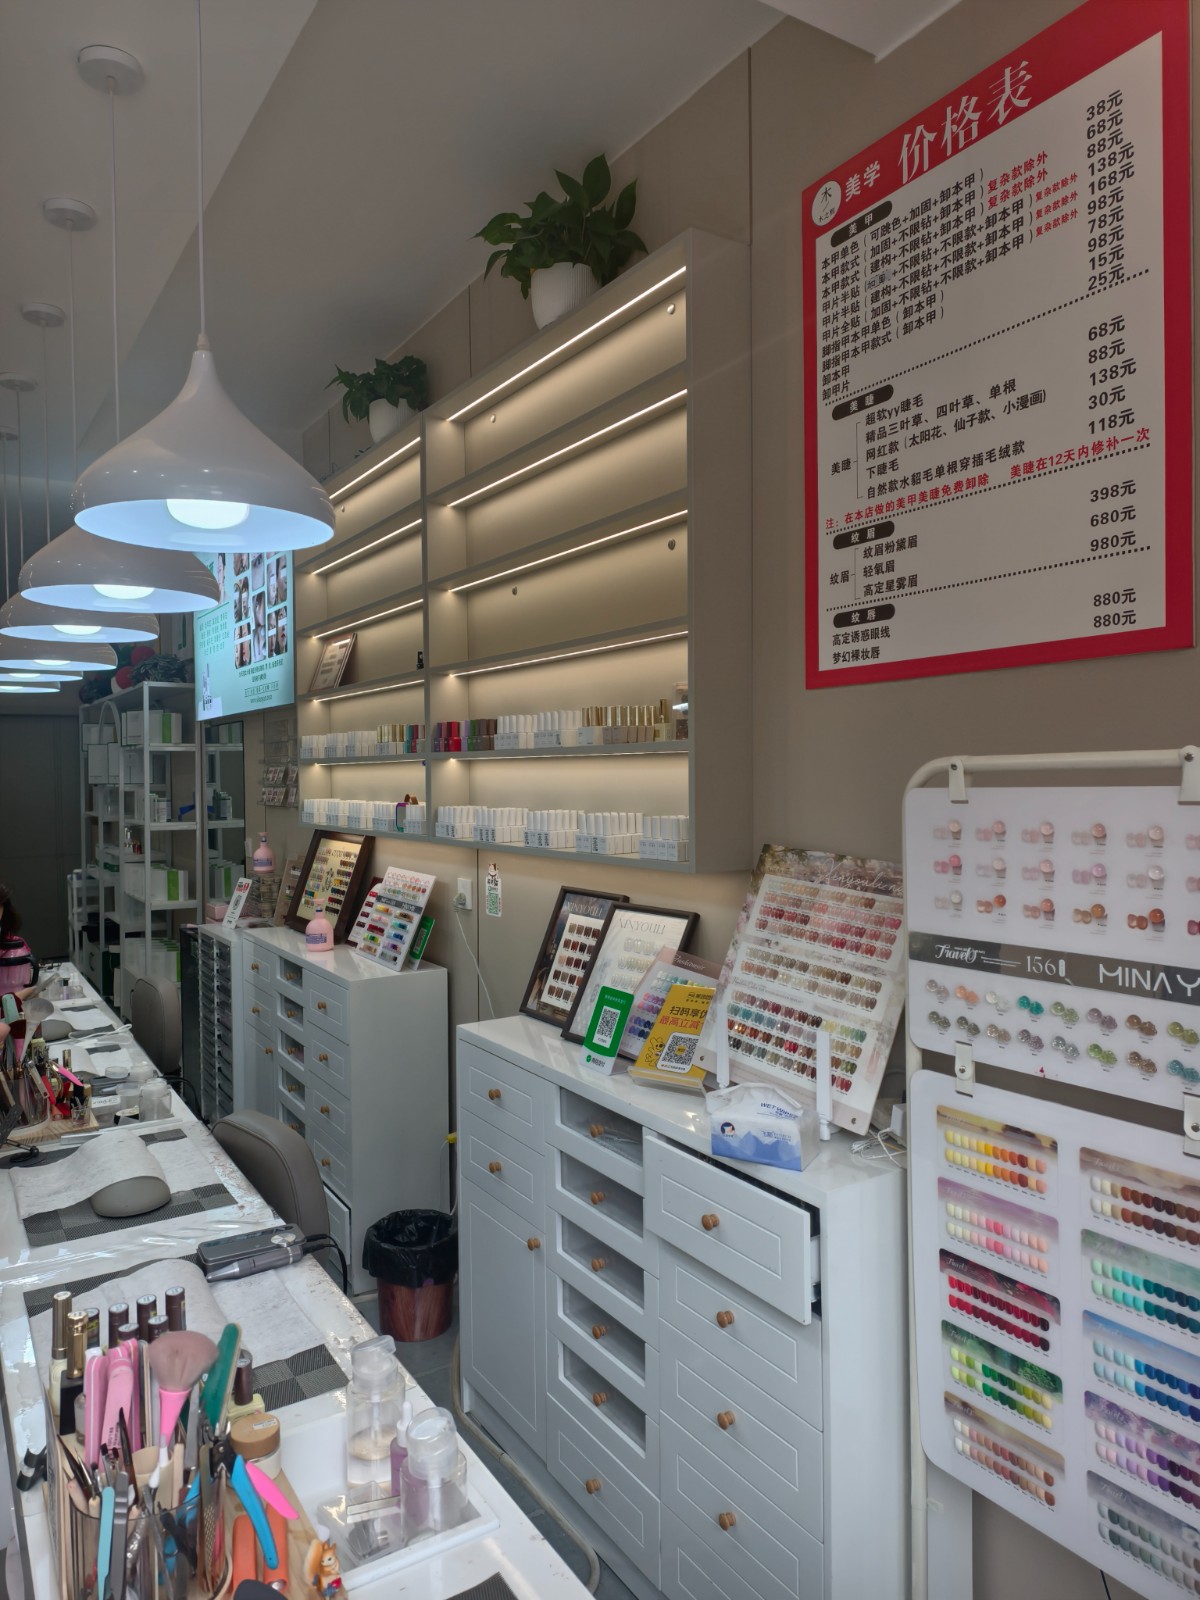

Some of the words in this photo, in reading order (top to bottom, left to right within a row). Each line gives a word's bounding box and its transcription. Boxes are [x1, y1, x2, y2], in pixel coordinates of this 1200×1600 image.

[1086, 89, 1123, 121] 38元
[898, 61, 1033, 184] 价格表
[1086, 109, 1124, 140] 68元
[1087, 128, 1124, 159] 88元
[987, 151, 1048, 194] 复杂款除外
[1088, 141, 1135, 177] 138元
[845, 160, 881, 202] 美学
[987, 168, 1048, 211] 复杂款除外
[1035, 172, 1078, 203] 复杂款除外
[1088, 161, 1135, 195] 168元
[1035, 190, 1079, 220] 复杂款除外
[1087, 186, 1124, 215] 98元
[1035, 208, 1079, 238] 复杂款除外
[1088, 205, 1124, 234] 78元
[1087, 224, 1125, 253] 98元
[1088, 243, 1125, 271] 15元
[1088, 263, 1125, 291] 25元
[1088, 314, 1126, 341] 68元
[1088, 338, 1126, 364] 88元
[822, 364, 850, 387] 卸本甲
[1089, 357, 1137, 386] 138元
[822, 379, 850, 401] 卸甲片
[1088, 385, 1126, 410] 30元
[865, 393, 924, 426] 超软yy睫毛
[865, 378, 1017, 444] 精品三叶草、四叶草、单根
[1088, 408, 1135, 435] 118元
[1010, 427, 1150, 479] 美睫在12天内修补一次
[831, 458, 851, 476] 美睫
[866, 458, 900, 480] 下睫毛
[1090, 479, 1137, 503] 398元
[1090, 504, 1137, 528] 680元
[850, 527, 876, 544] 纹眉
[863, 534, 918, 559] 纹眉粉黛眉
[1090, 530, 1137, 553] 980元
[829, 570, 850, 586] 纹眉
[863, 574, 918, 597] 高定星雾眉
[1093, 588, 1137, 609] 880元
[1093, 609, 1137, 629] 880元
[832, 625, 891, 647] 高定诱惑眼线
[832, 646, 881, 665] 梦幻裸妆唇
[1026, 955, 1056, 976] 156
[659, 1015, 704, 1030] 最高立减
